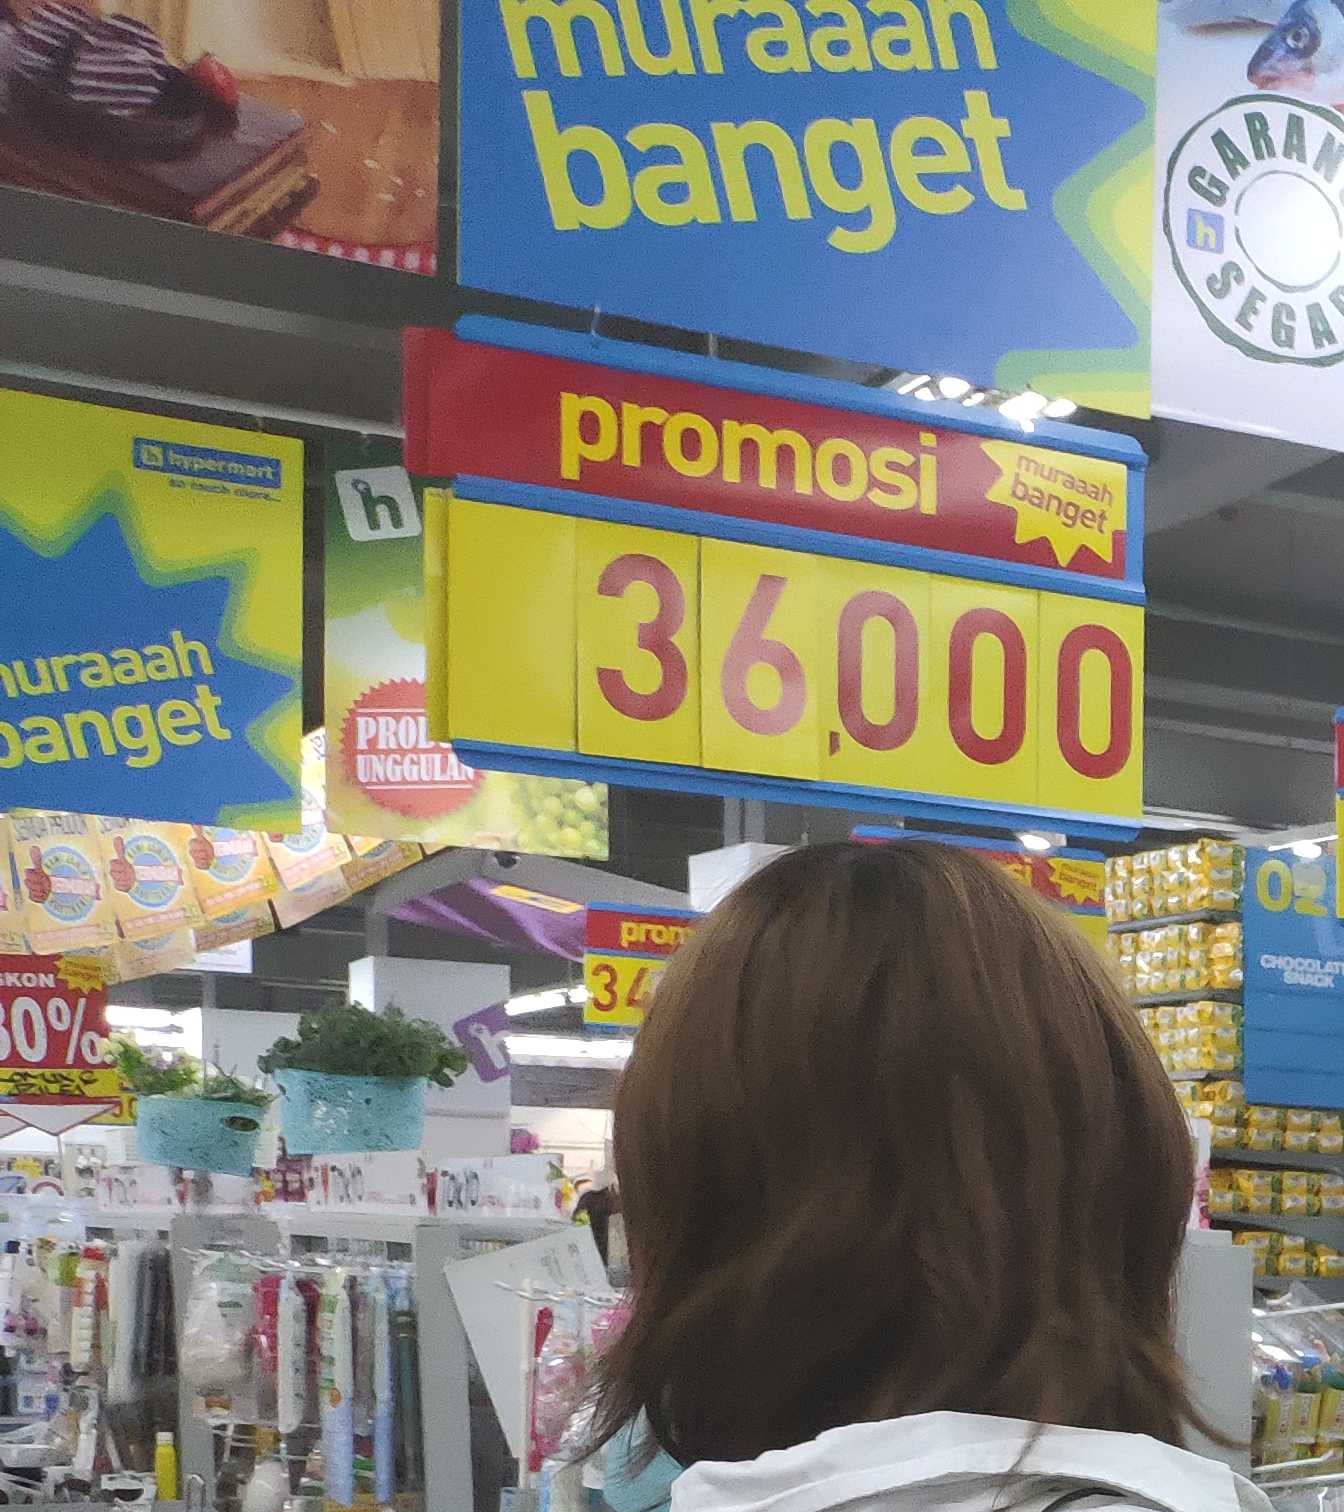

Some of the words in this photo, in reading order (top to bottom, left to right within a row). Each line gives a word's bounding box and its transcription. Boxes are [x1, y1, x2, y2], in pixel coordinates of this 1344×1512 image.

[524, 88, 1027, 254] banget
[560, 392, 938, 515] promosi
[1016, 451, 1114, 507] muraaah
[1009, 478, 1110, 535] banget
[596, 554, 1133, 780] 36,000
[357, 754, 474, 784] UNGGULAN
[0, 971, 56, 988] KON
[1283, 970, 1335, 988] SNACK
